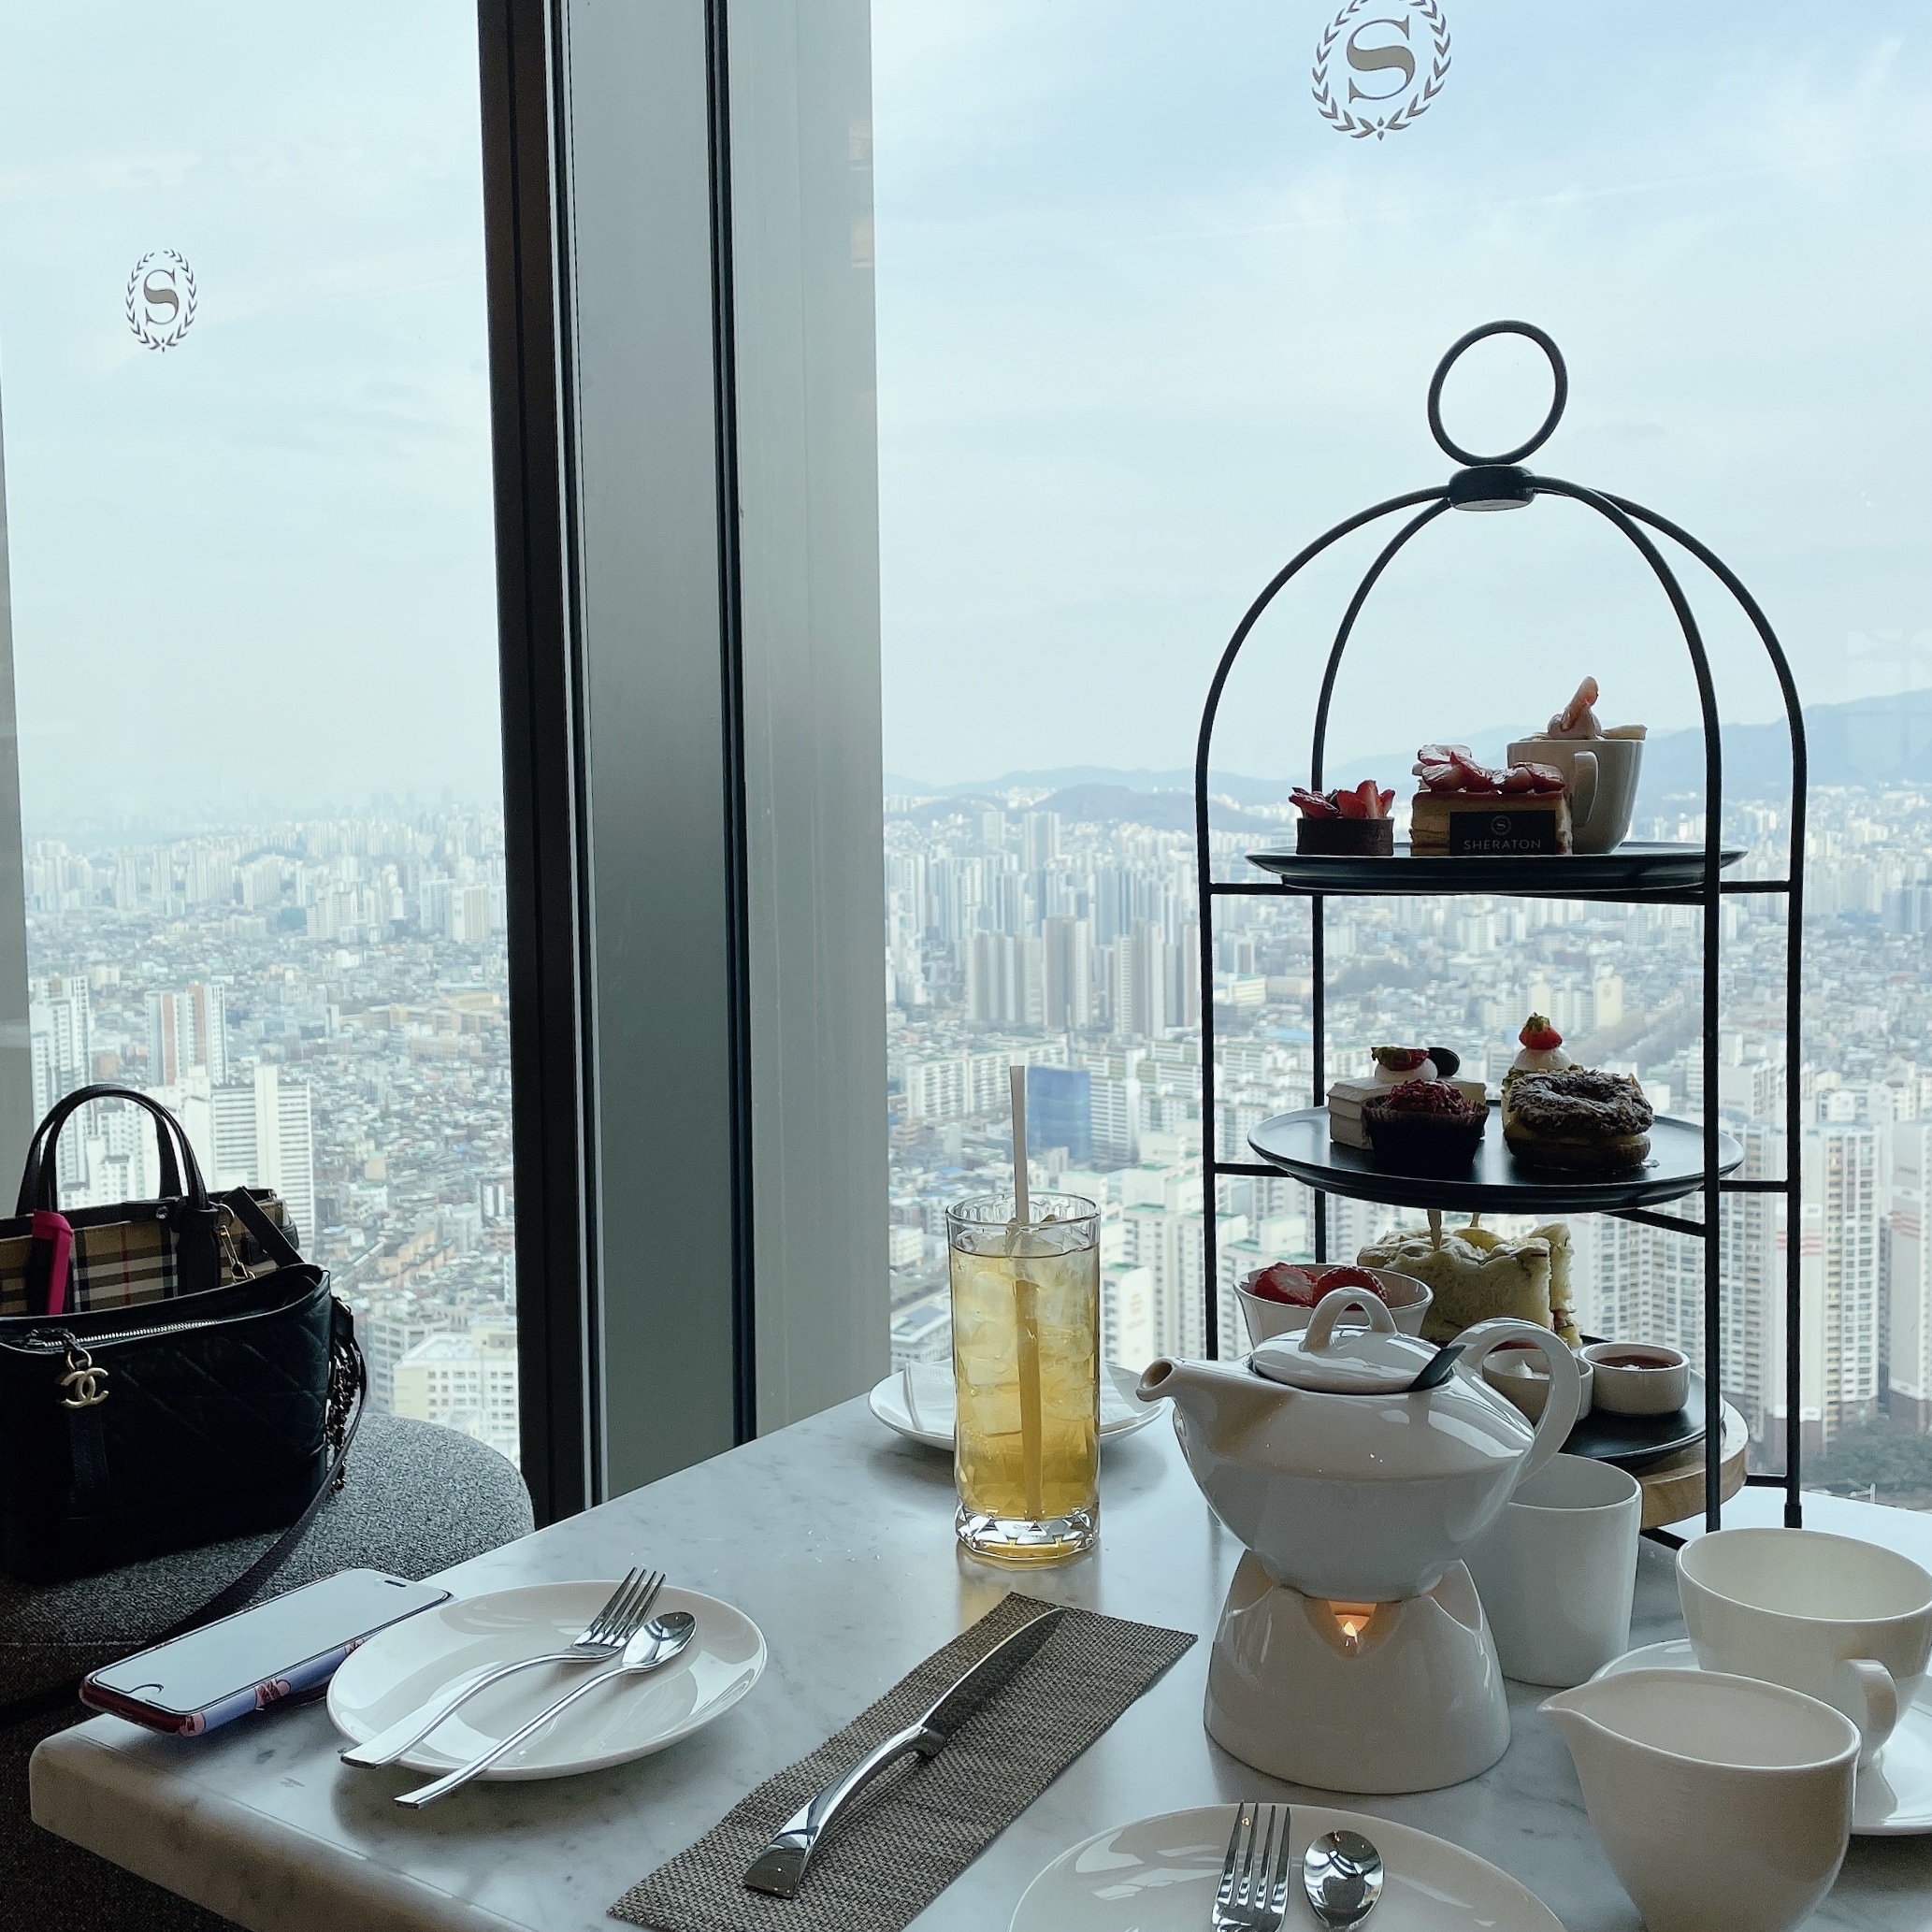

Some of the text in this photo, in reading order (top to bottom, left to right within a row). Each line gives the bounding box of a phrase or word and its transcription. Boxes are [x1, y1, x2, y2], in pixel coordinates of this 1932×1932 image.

[1347, 14, 1416, 104] S
[143, 267, 180, 325] S
[1463, 839, 1541, 850] SHERATON
